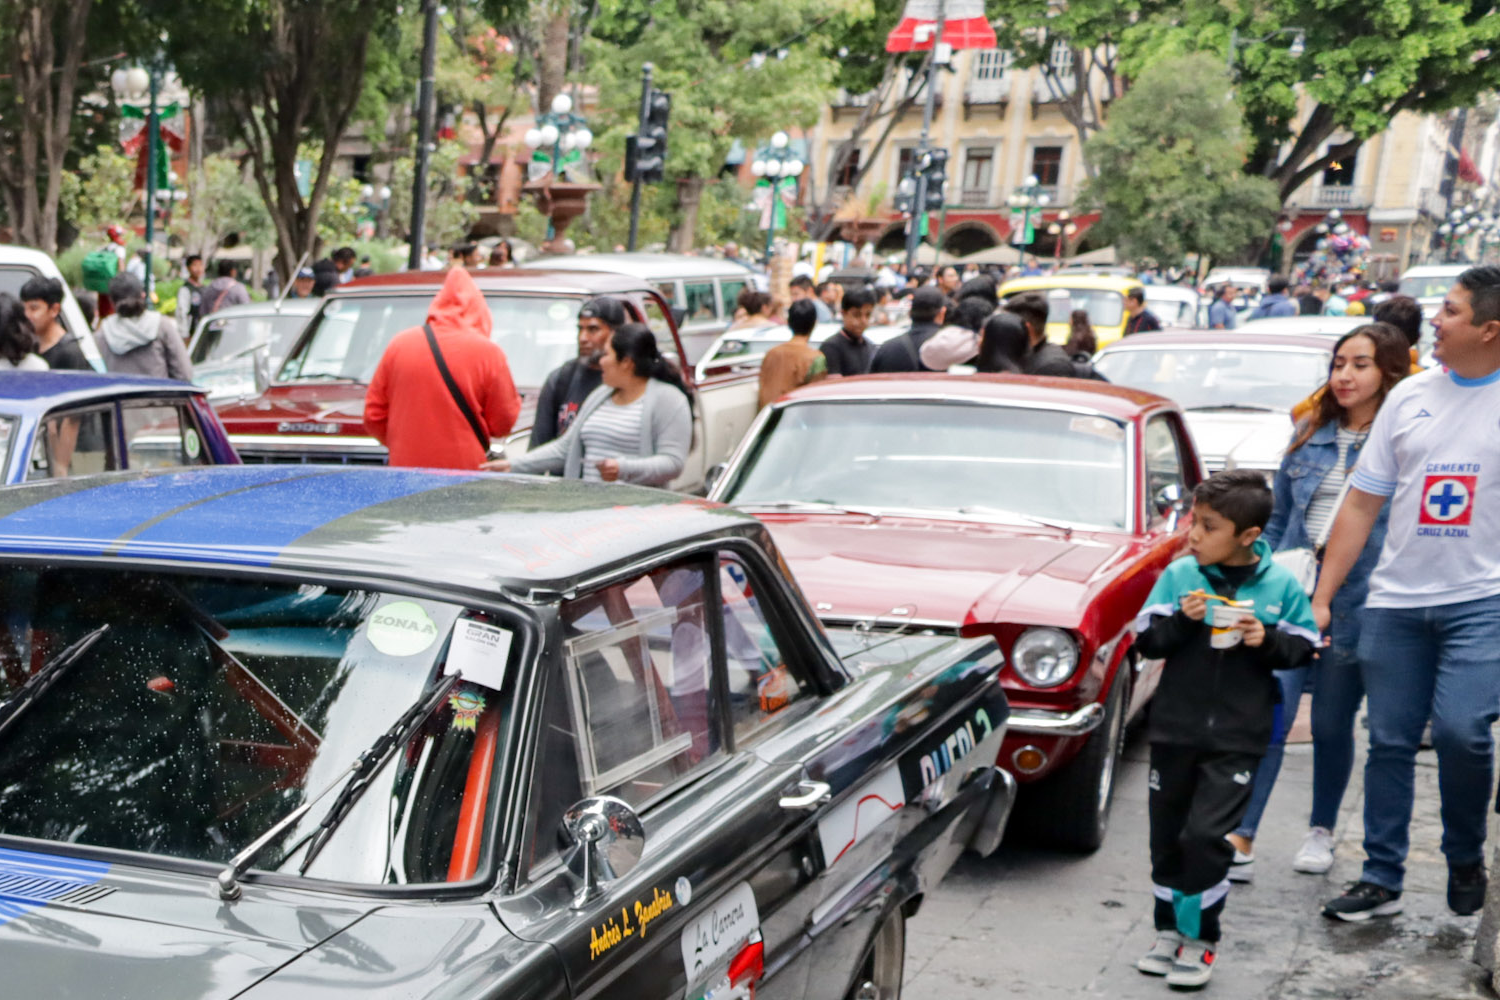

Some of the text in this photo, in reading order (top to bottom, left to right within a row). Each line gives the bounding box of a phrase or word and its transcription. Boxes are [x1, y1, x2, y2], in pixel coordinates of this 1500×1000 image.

[1426, 463, 1481, 473] CEMENTO
[1417, 527, 1471, 538] CRUZ AZUL
[373, 614, 434, 635] ZONA A
[623, 907, 634, 937] L.
[695, 903, 744, 955] La Carrera
